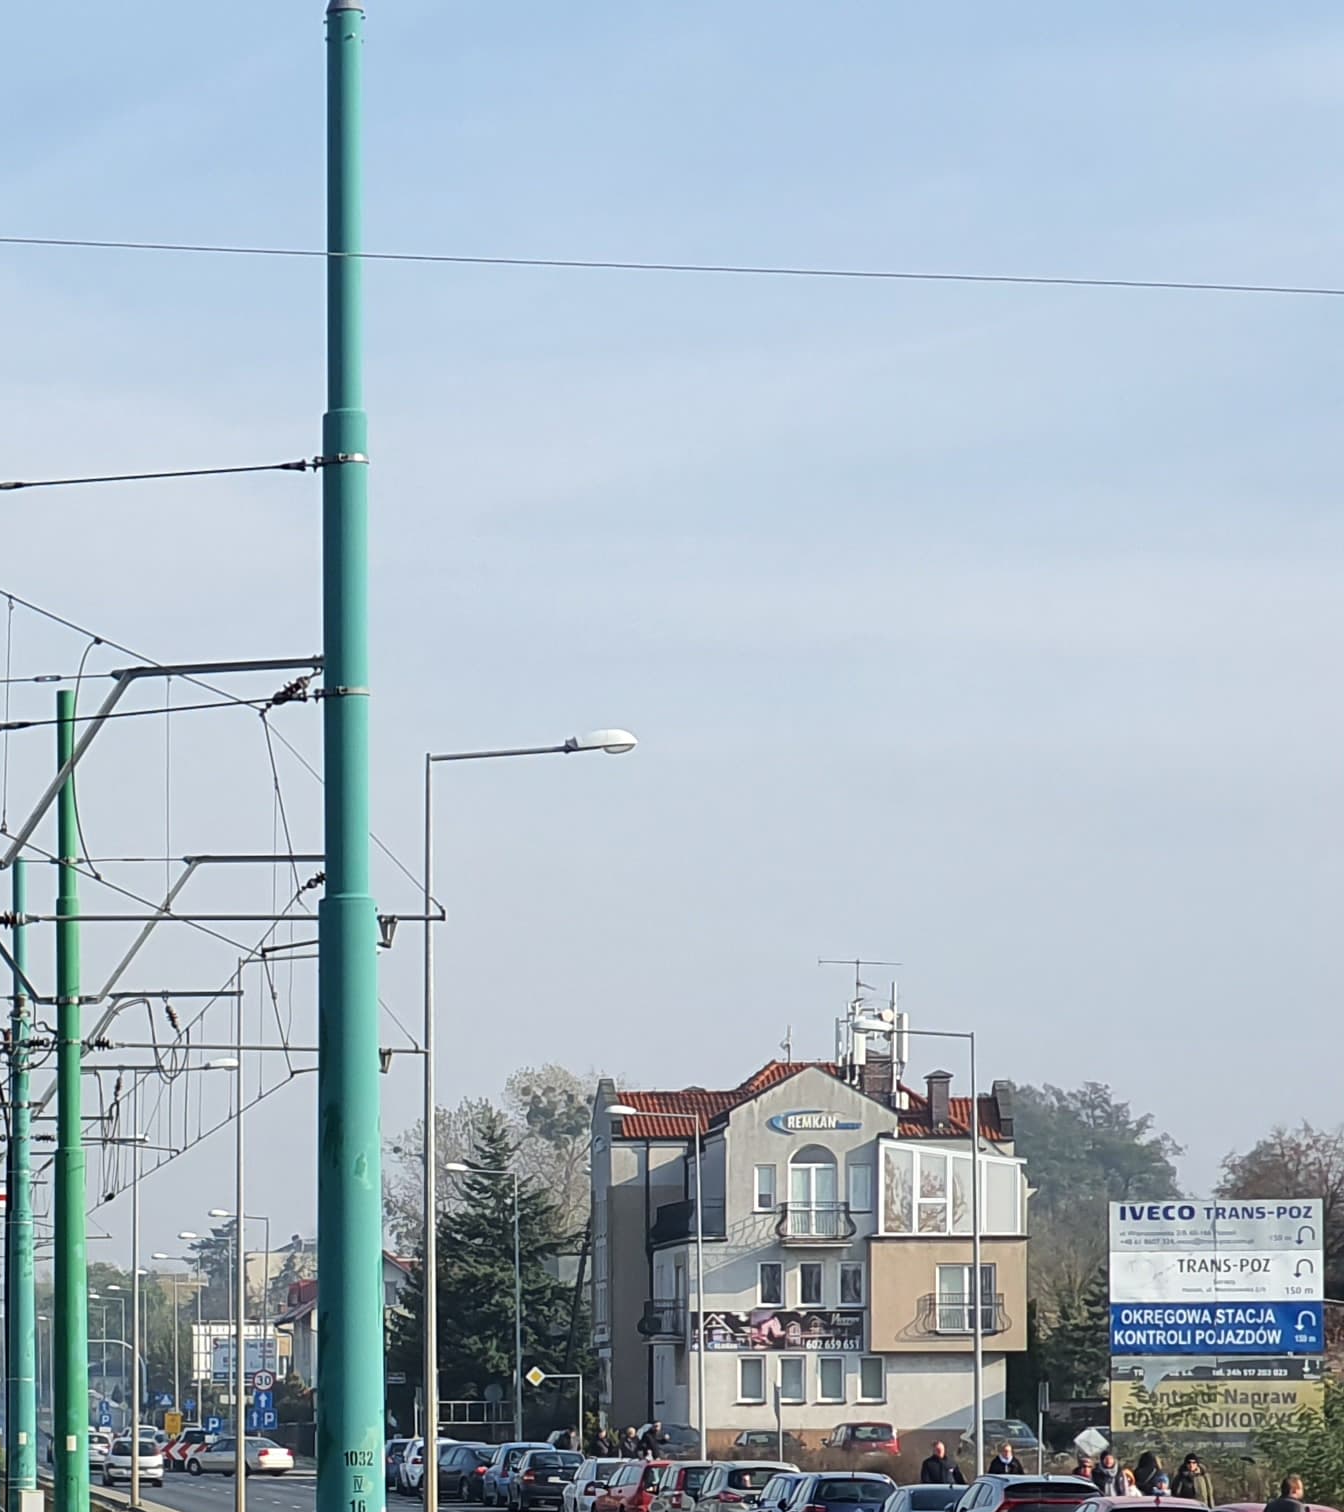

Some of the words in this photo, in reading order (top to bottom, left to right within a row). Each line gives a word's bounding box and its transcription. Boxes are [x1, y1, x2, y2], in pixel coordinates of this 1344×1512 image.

[787, 1115, 837, 1129] REMKAN
[1119, 1204, 1196, 1221] IVECO
[1203, 1205, 1313, 1220] TRANS-POZ
[1176, 1258, 1272, 1273] TRANS-POZ
[1284, 1286, 1302, 1295] 150
[1304, 1287, 1314, 1295] m
[1120, 1309, 1212, 1328] OKRĘGOWA
[1215, 1308, 1276, 1325] STACJA
[805, 1338, 823, 1350] 602
[824, 1337, 842, 1350] 659
[1113, 1330, 1191, 1345] KONTROLI
[1195, 1327, 1283, 1345] POJAZDÓW
[256, 1375, 272, 1386] 30
[344, 1450, 374, 1467] 1032
